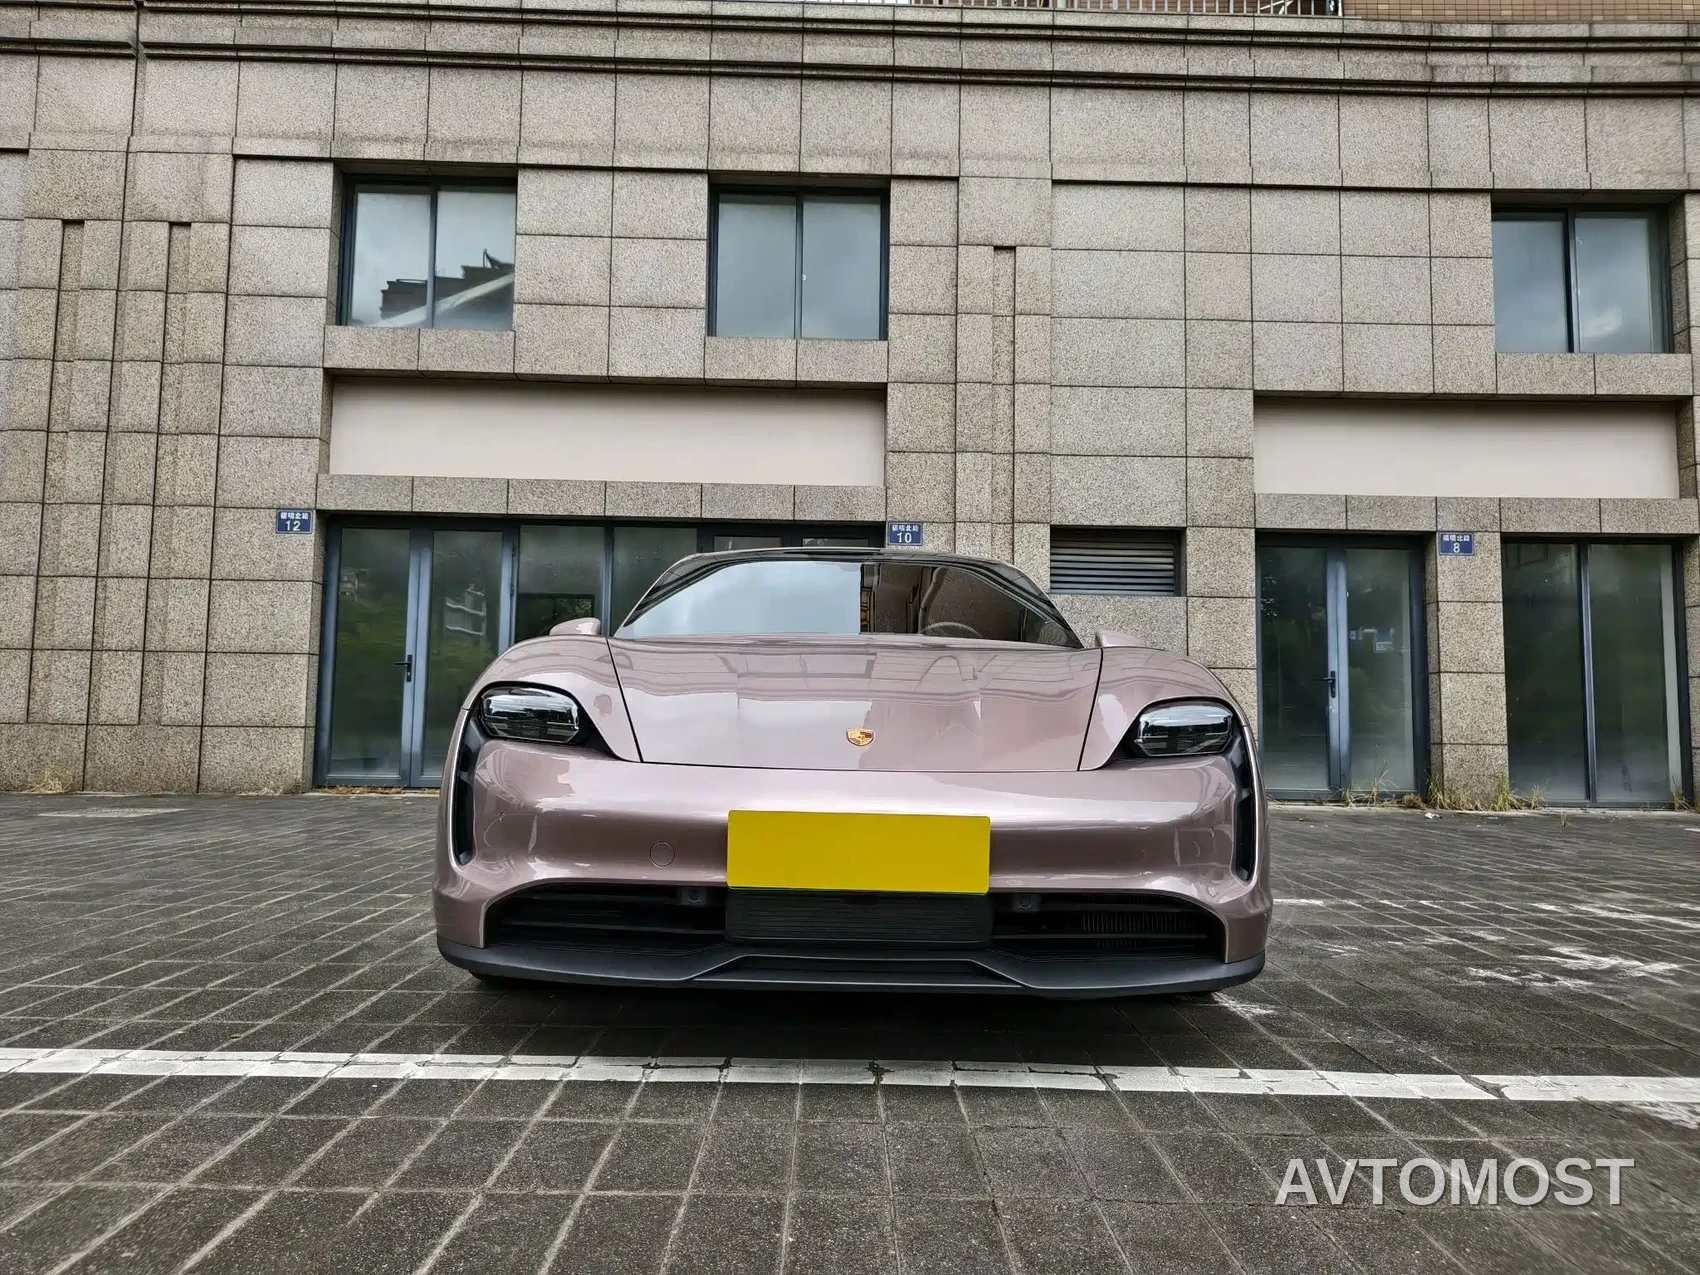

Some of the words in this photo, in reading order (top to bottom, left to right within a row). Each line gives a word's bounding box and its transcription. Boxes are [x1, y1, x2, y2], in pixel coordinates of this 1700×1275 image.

[285, 520, 301, 531] 12
[897, 532, 912, 543] 10
[1453, 542, 1460, 553] 8
